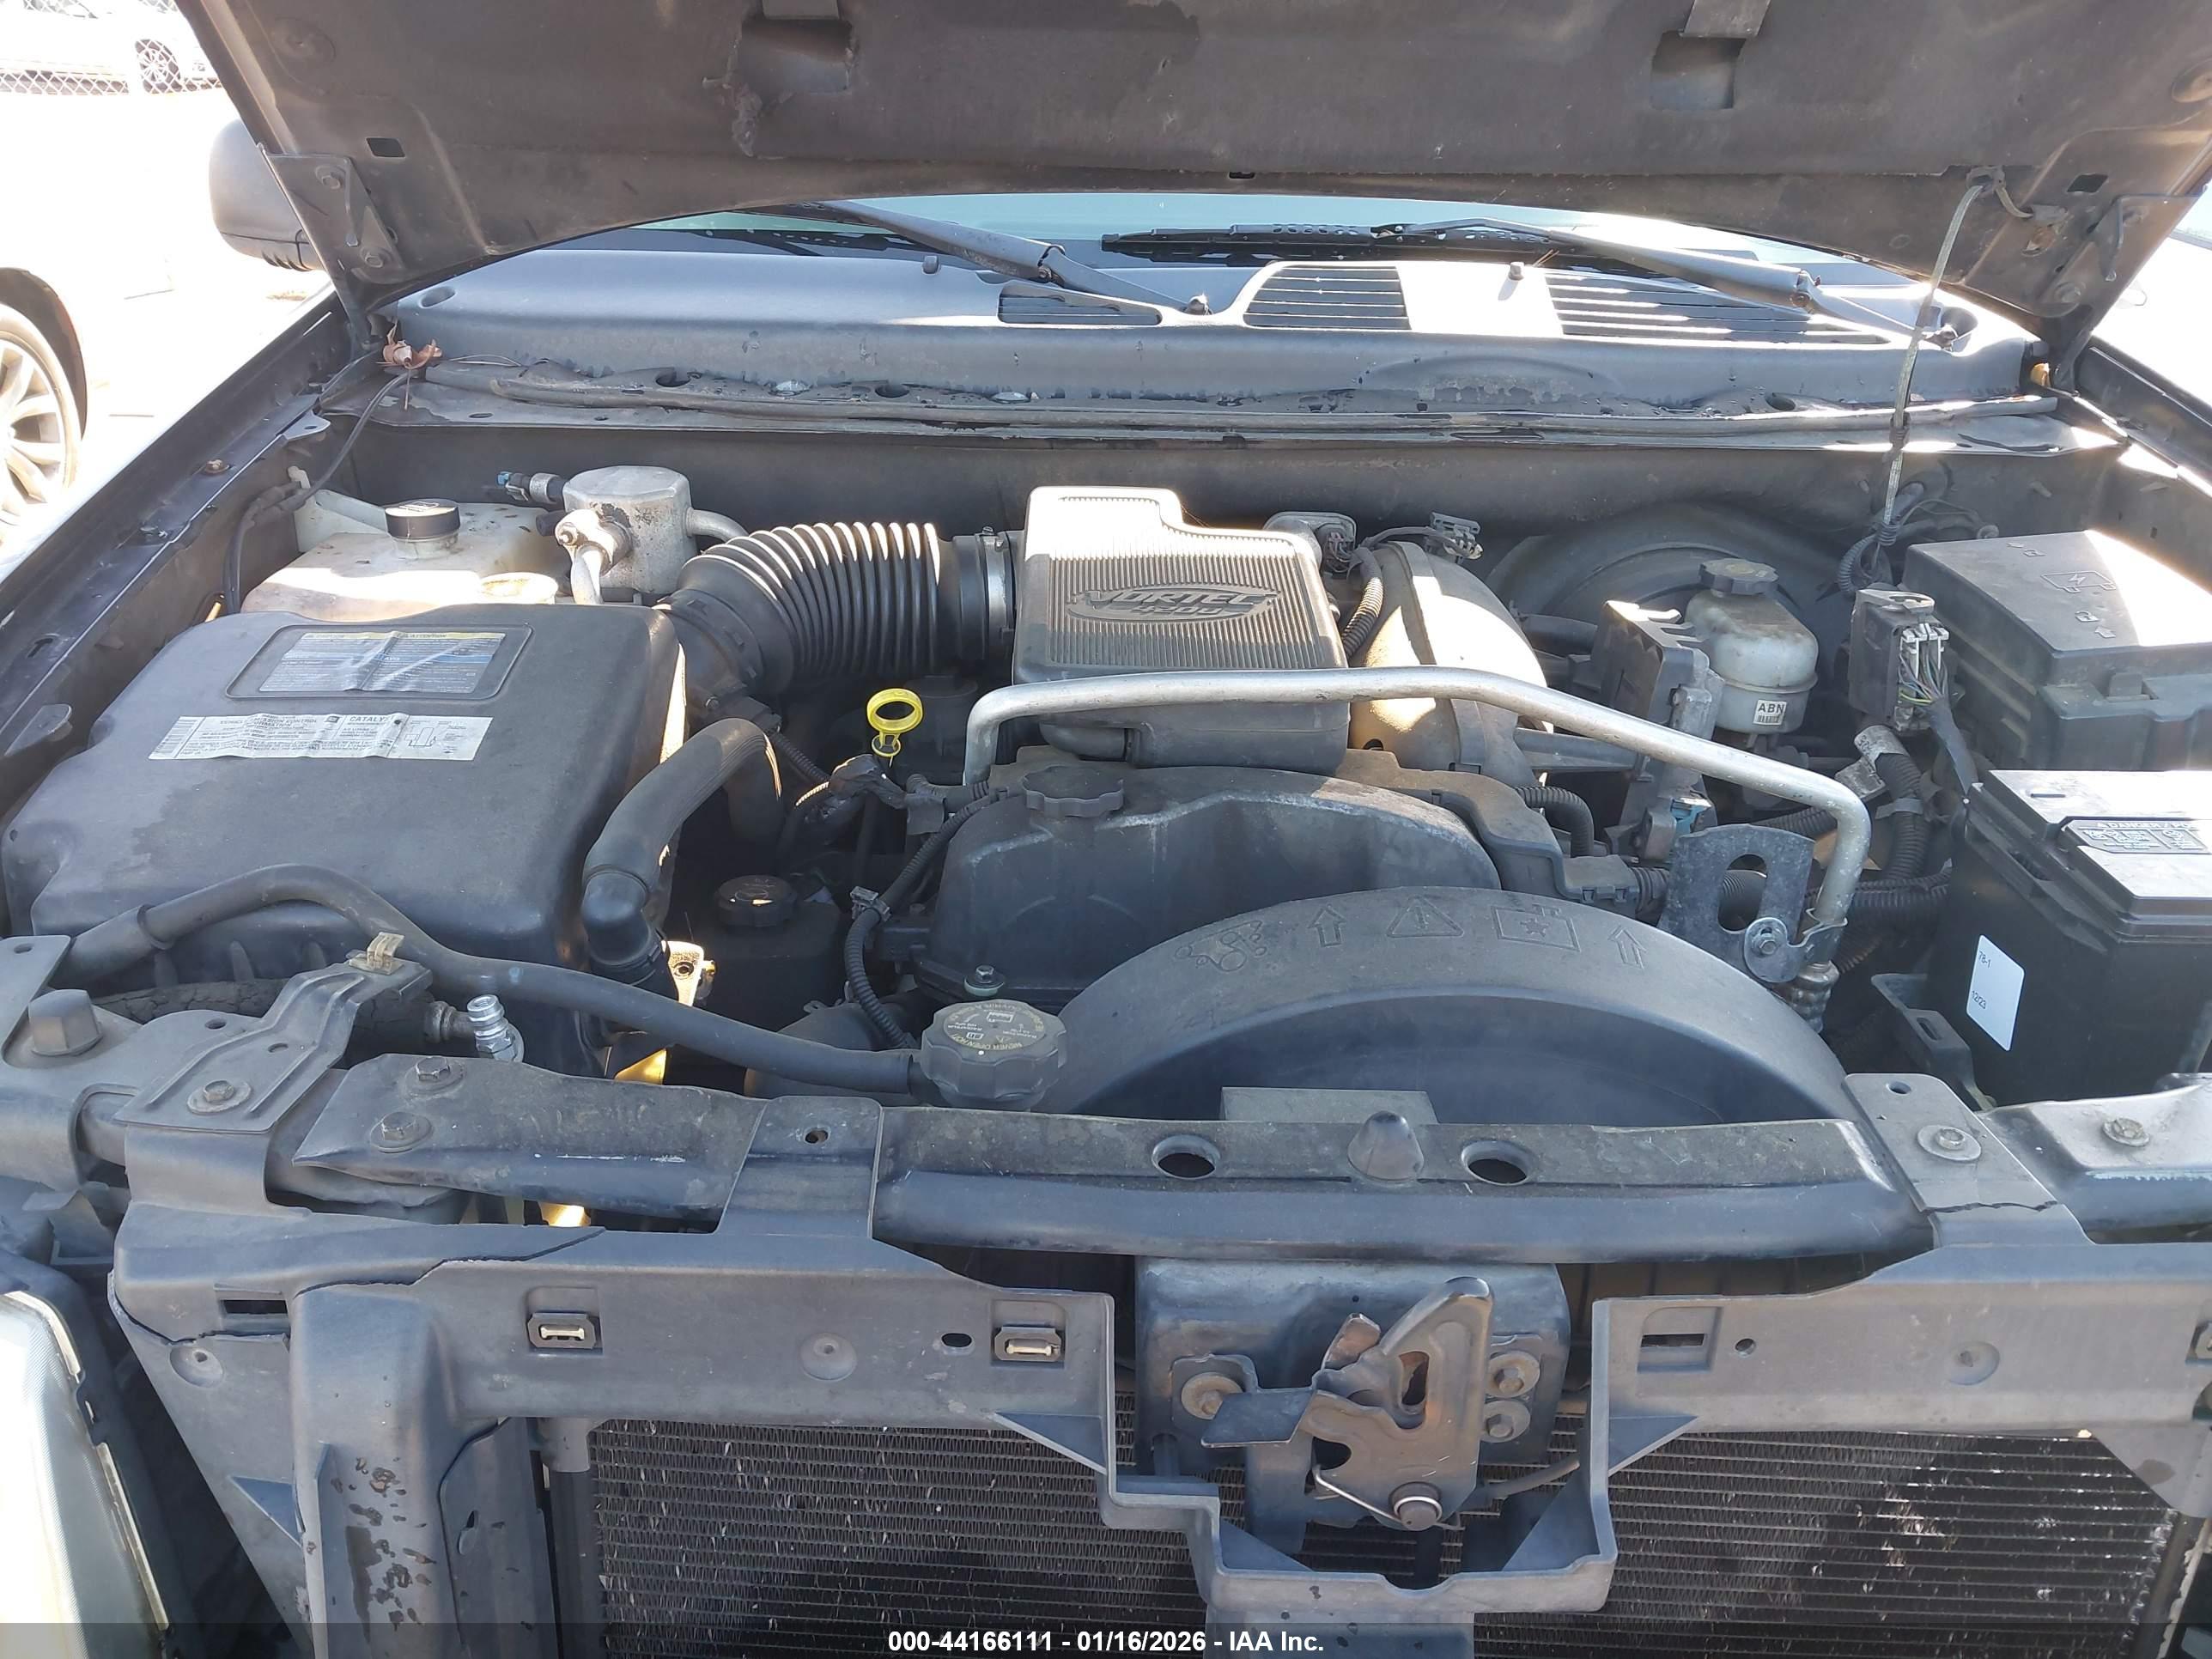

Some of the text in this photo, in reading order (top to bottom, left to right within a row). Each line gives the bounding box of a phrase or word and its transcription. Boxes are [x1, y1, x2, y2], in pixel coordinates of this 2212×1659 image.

[1085, 589, 1273, 607] VORTEC
[1131, 605, 1223, 616] 4200
[1758, 702, 1785, 714] ABN
